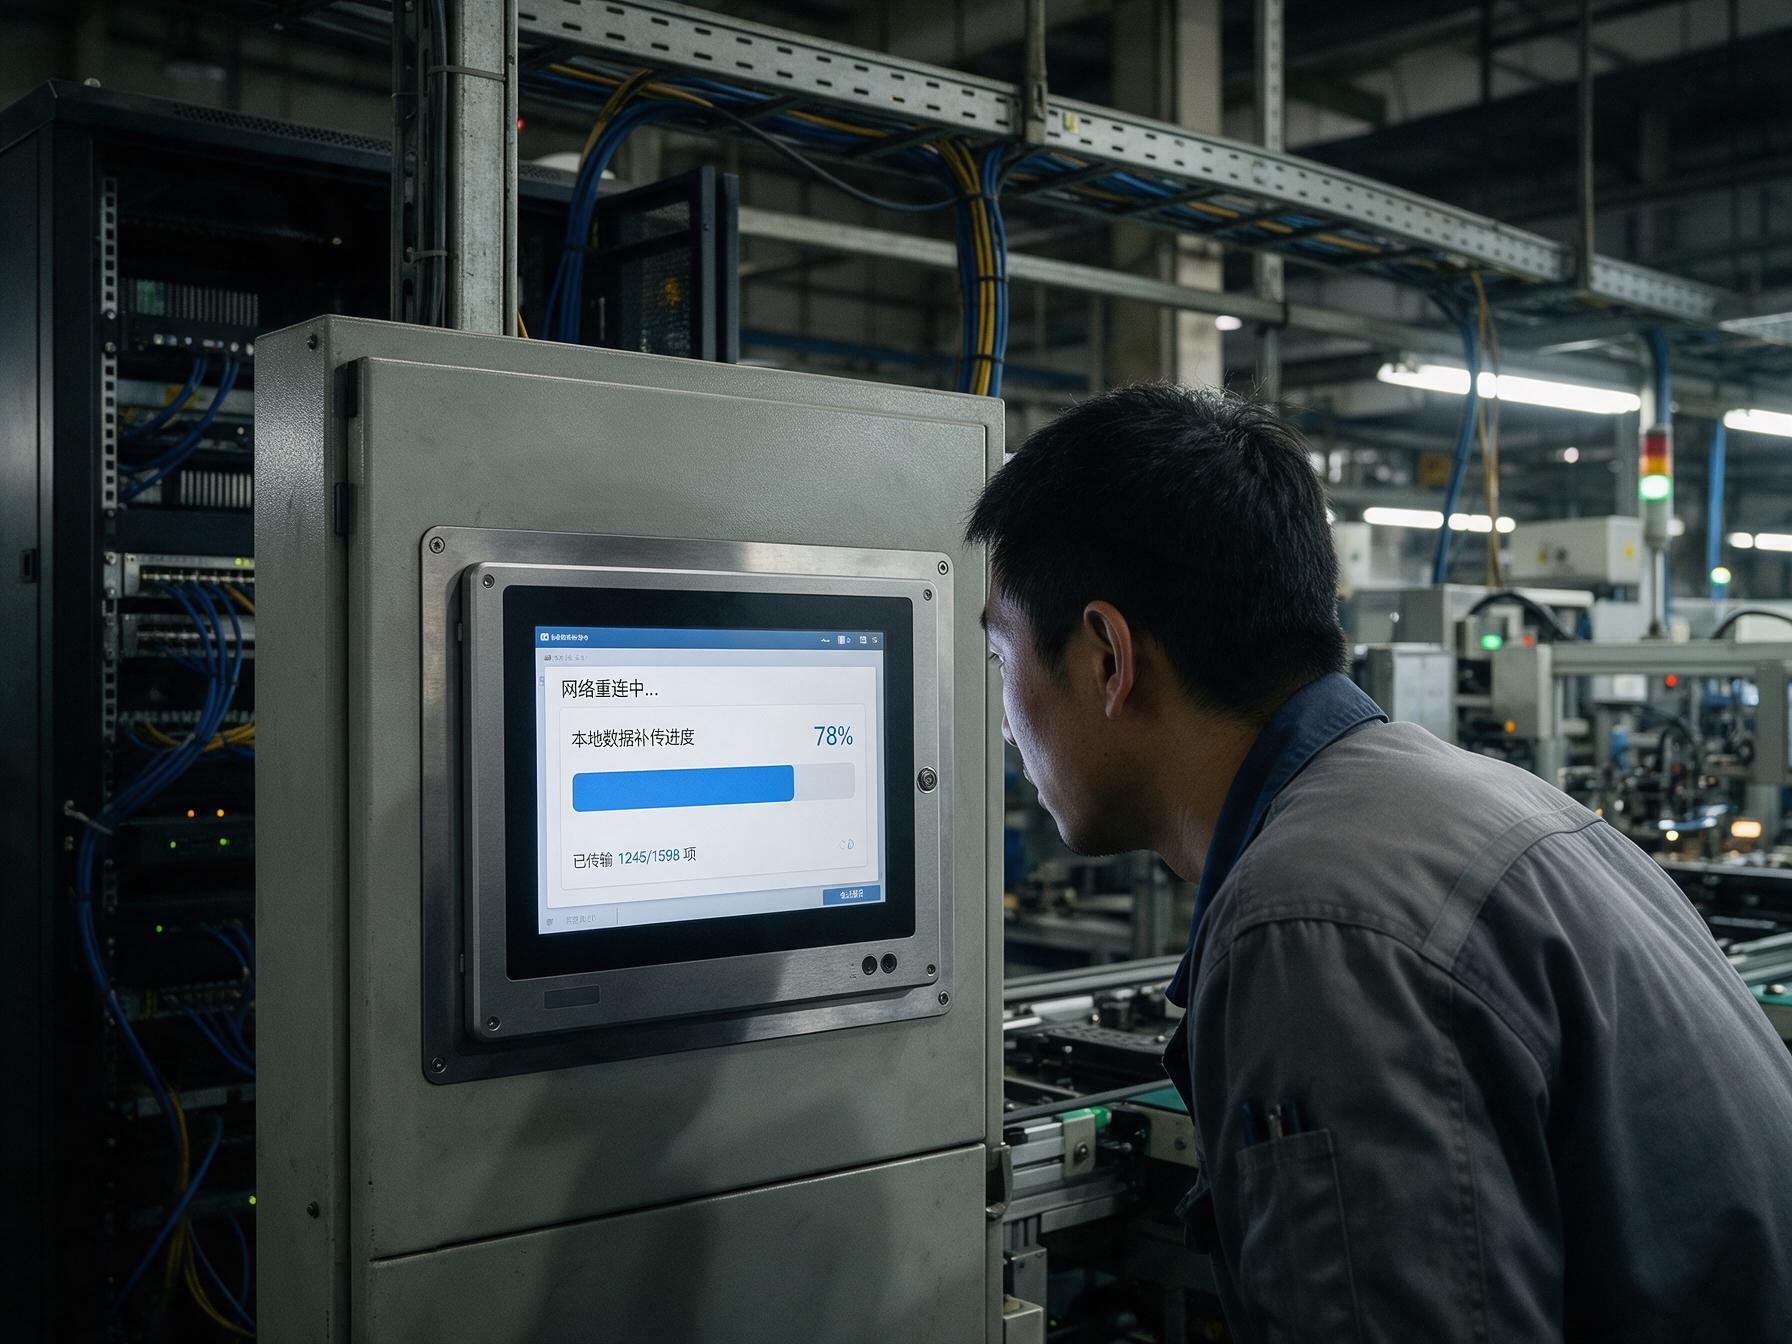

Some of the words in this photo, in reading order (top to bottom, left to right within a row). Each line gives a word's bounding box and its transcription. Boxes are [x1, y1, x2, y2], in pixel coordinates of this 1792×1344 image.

[561, 678, 659, 699] 网络重连中...
[571, 727, 695, 749] 本地数据补传进度
[814, 725, 854, 747] 78%
[573, 851, 614, 869] 已传输
[618, 848, 681, 865] 1245/1598
[683, 846, 697, 862] 项
